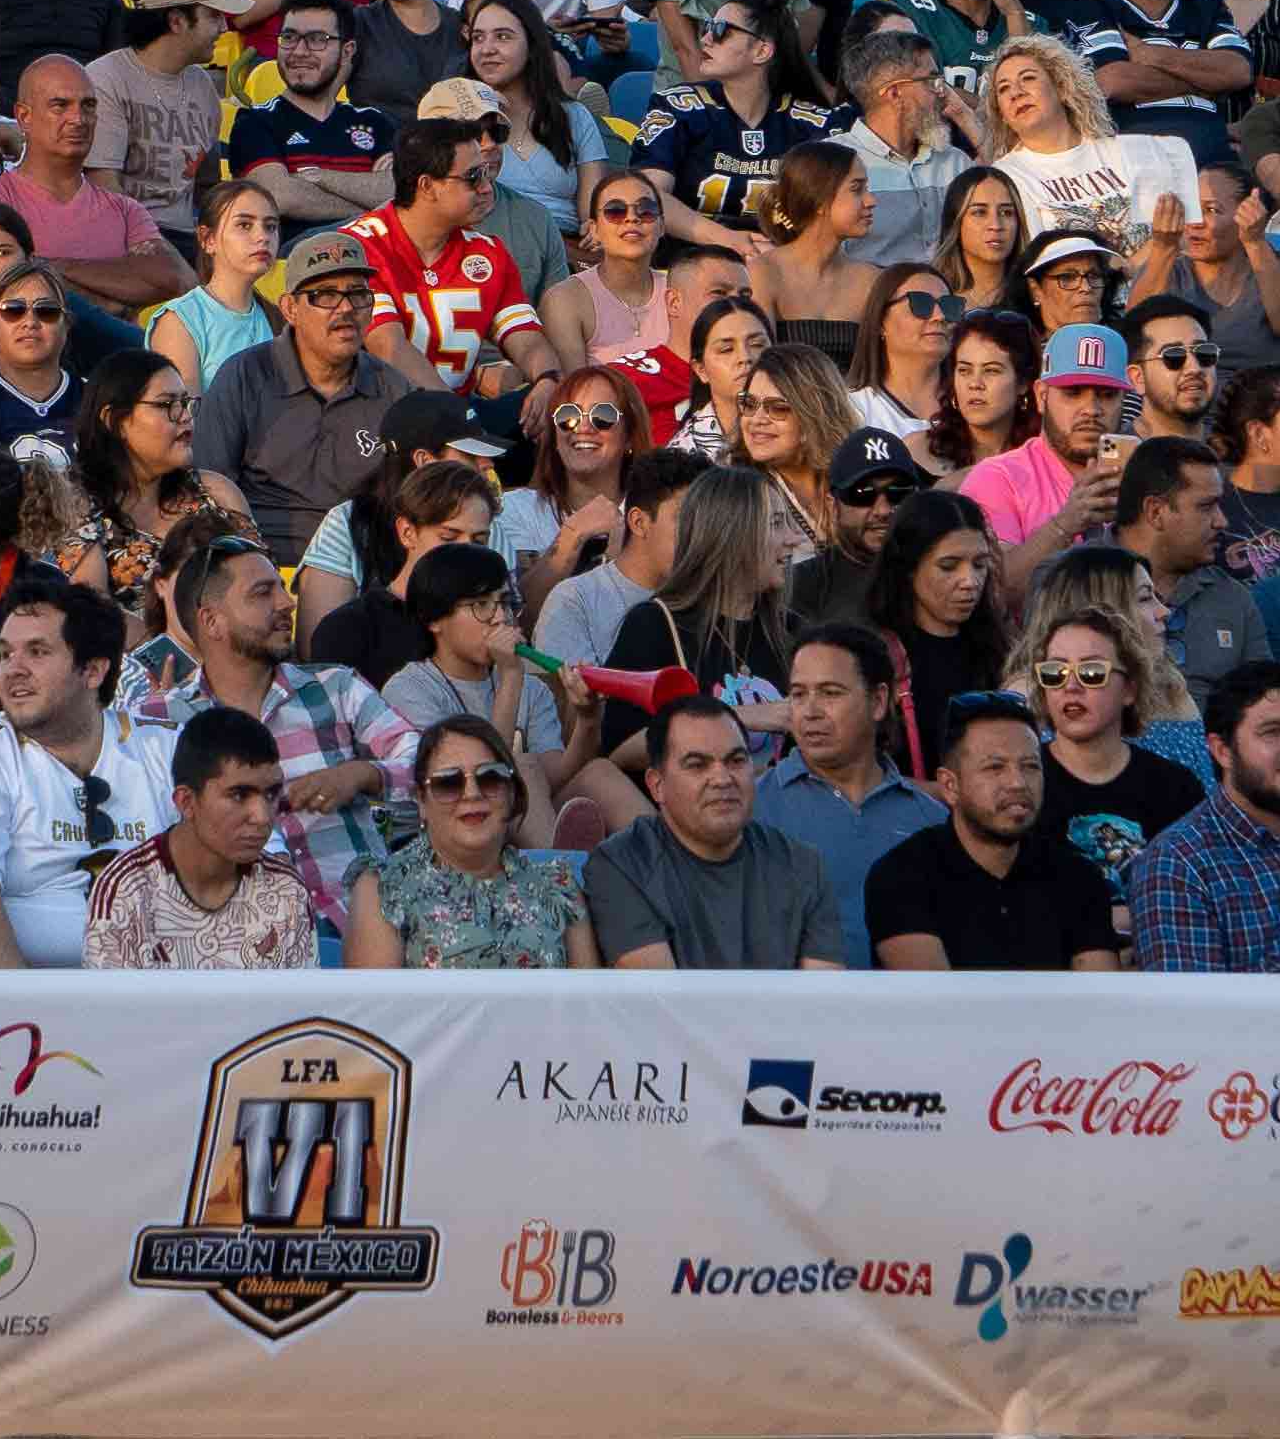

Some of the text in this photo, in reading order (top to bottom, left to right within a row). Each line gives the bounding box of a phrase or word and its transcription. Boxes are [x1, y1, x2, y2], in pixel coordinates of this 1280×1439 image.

[1040, 167, 1128, 202] NIRVANA
[402, 288, 482, 390] 15
[865, 437, 890, 460] NY
[280, 1059, 340, 1082] LFA
[496, 1060, 689, 1103] AKARI
[555, 1105, 689, 1124] JAPANESE BISTRO
[233, 1096, 376, 1225] VI
[151, 1225, 421, 1275] TAZÓN MÉXICO
[236, 1276, 330, 1298] Chihuahua
[485, 1308, 559, 1326] Boneless
